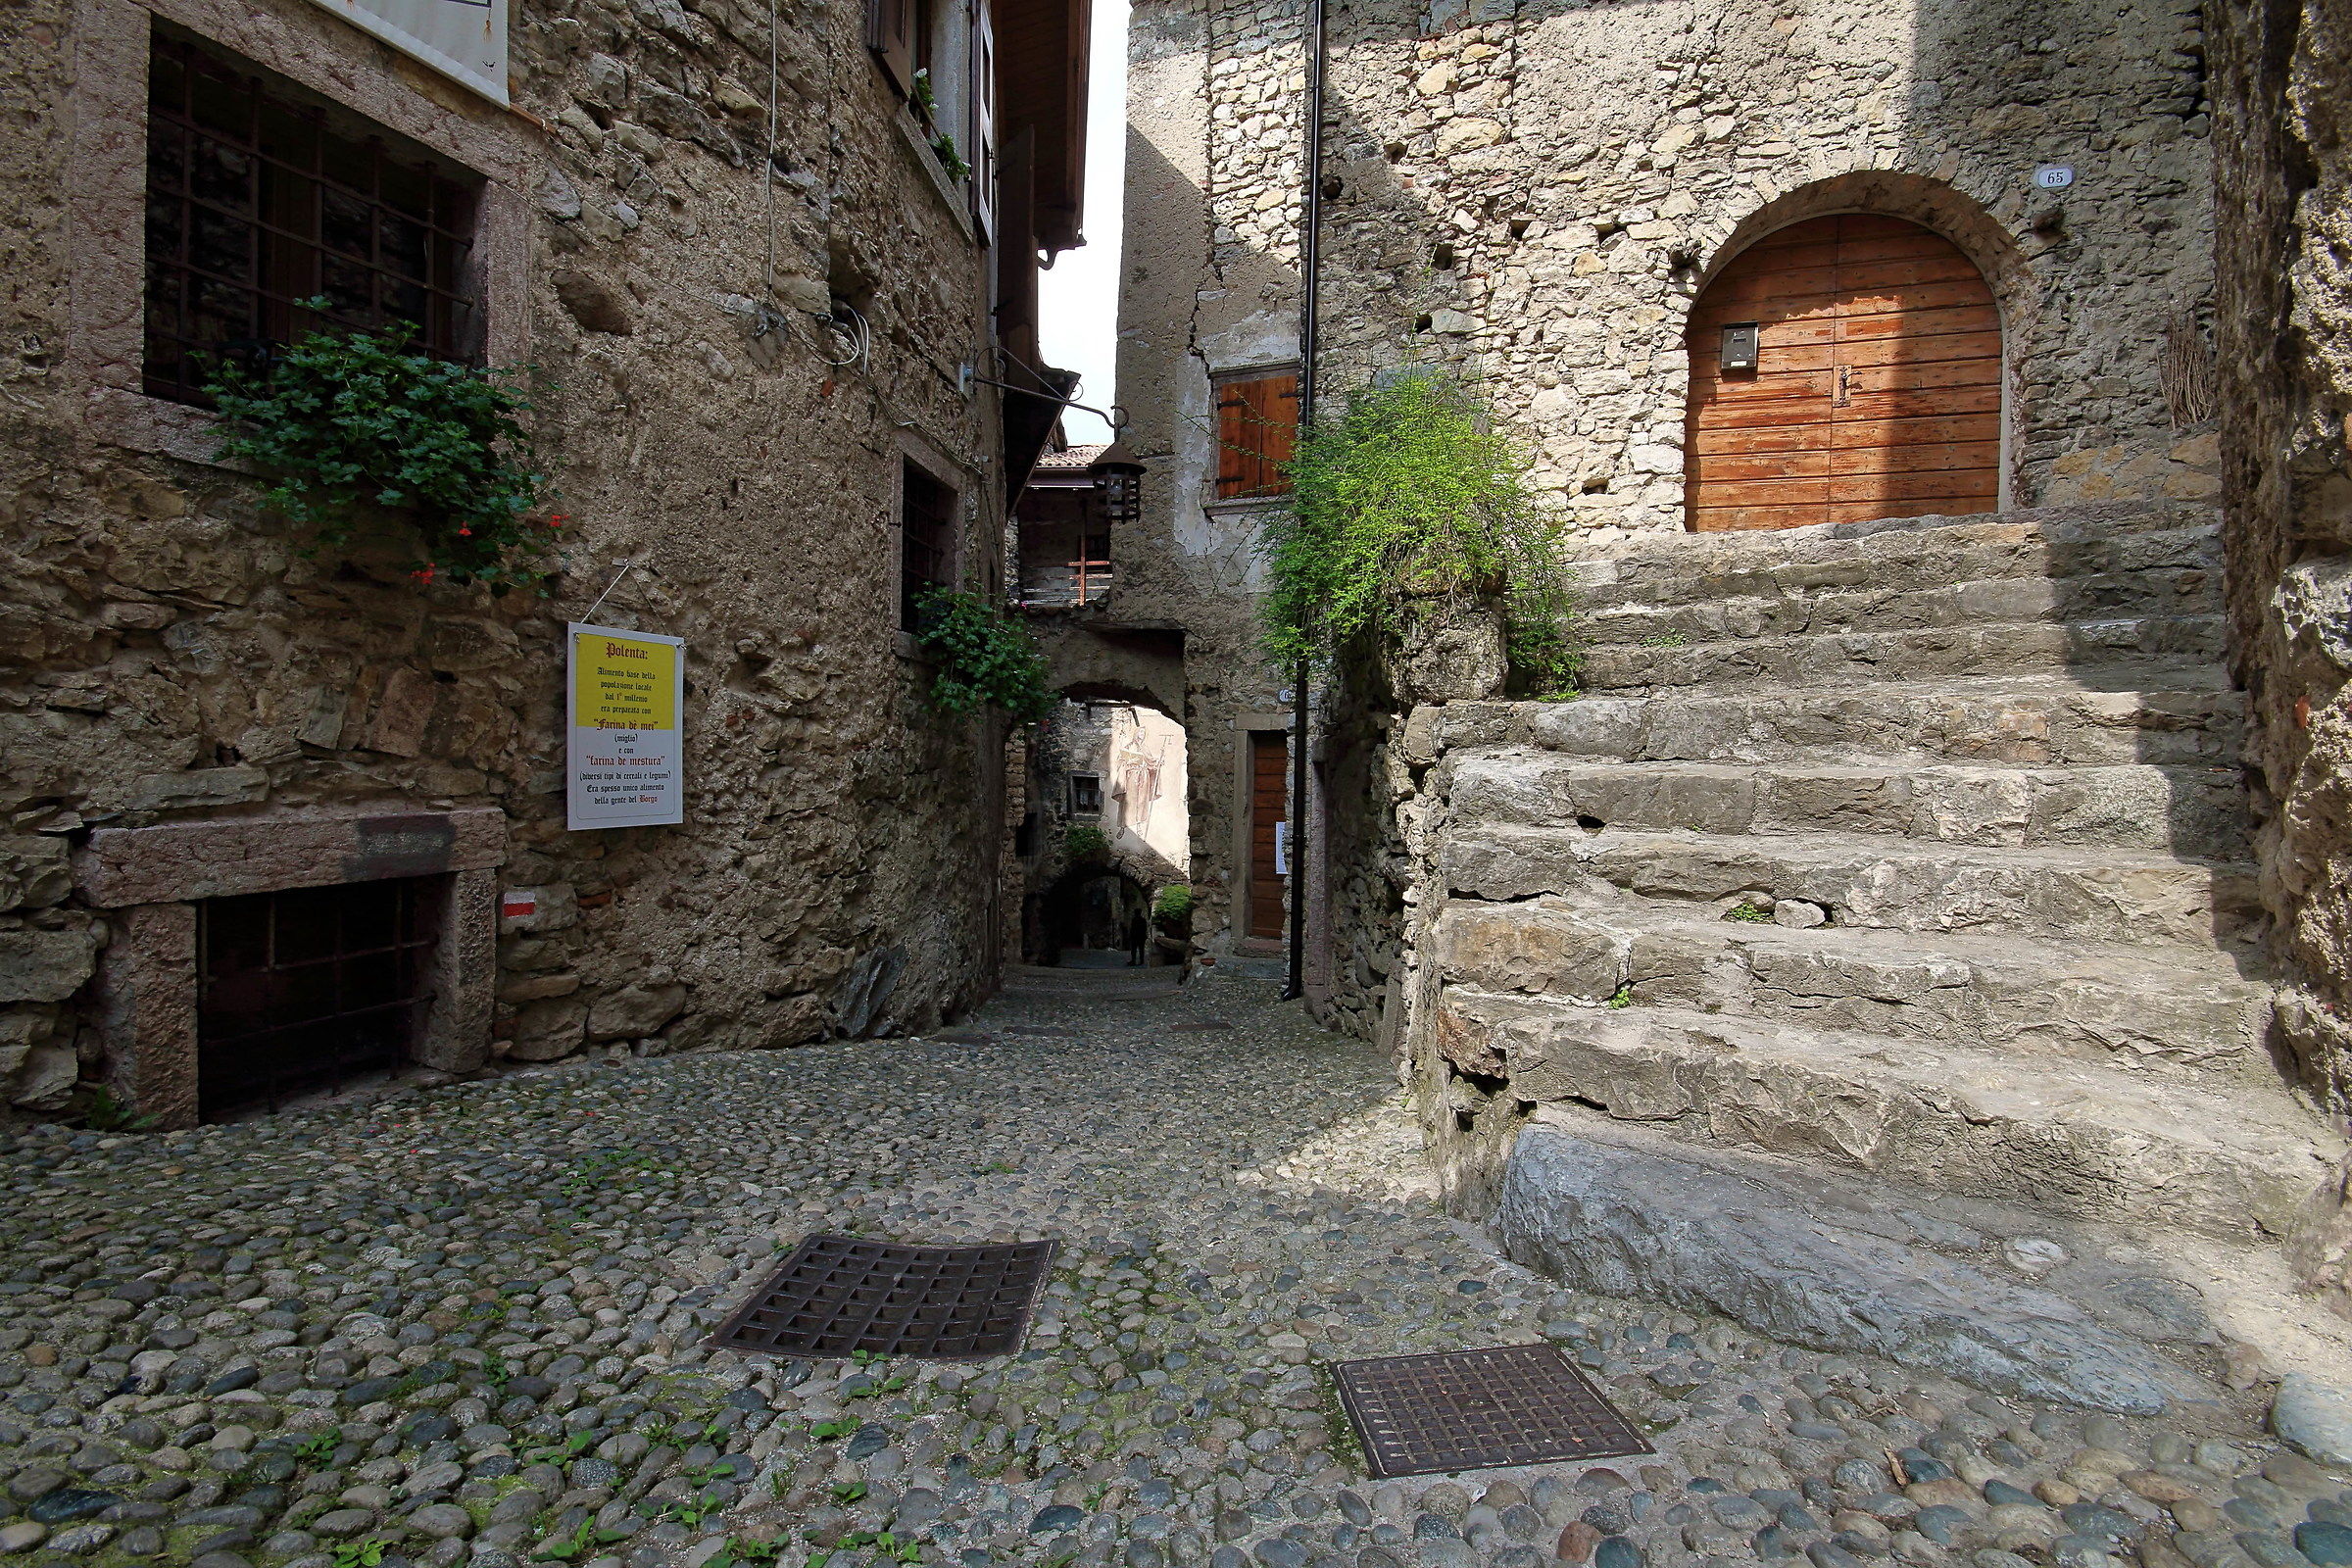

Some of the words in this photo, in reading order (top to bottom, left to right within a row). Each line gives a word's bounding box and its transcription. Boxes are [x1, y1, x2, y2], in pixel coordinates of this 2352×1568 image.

[2047, 172, 2064, 184] 65
[606, 642, 648, 660] Polenta:
[597, 666, 624, 677] Alimento
[626, 670, 640, 679] base
[635, 682, 652, 691] locale
[605, 692, 614, 701] dal
[613, 733, 638, 744] (miglio)
[579, 771, 603, 781] (diversi
[604, 772, 614, 781] tipi
[649, 770, 671, 781] legumi)
[586, 784, 599, 793] Era
[600, 784, 621, 793] spesso
[622, 783, 638, 792] unico
[594, 796, 609, 805] della
[628, 795, 637, 804] del
[638, 794, 658, 804] Borgo
